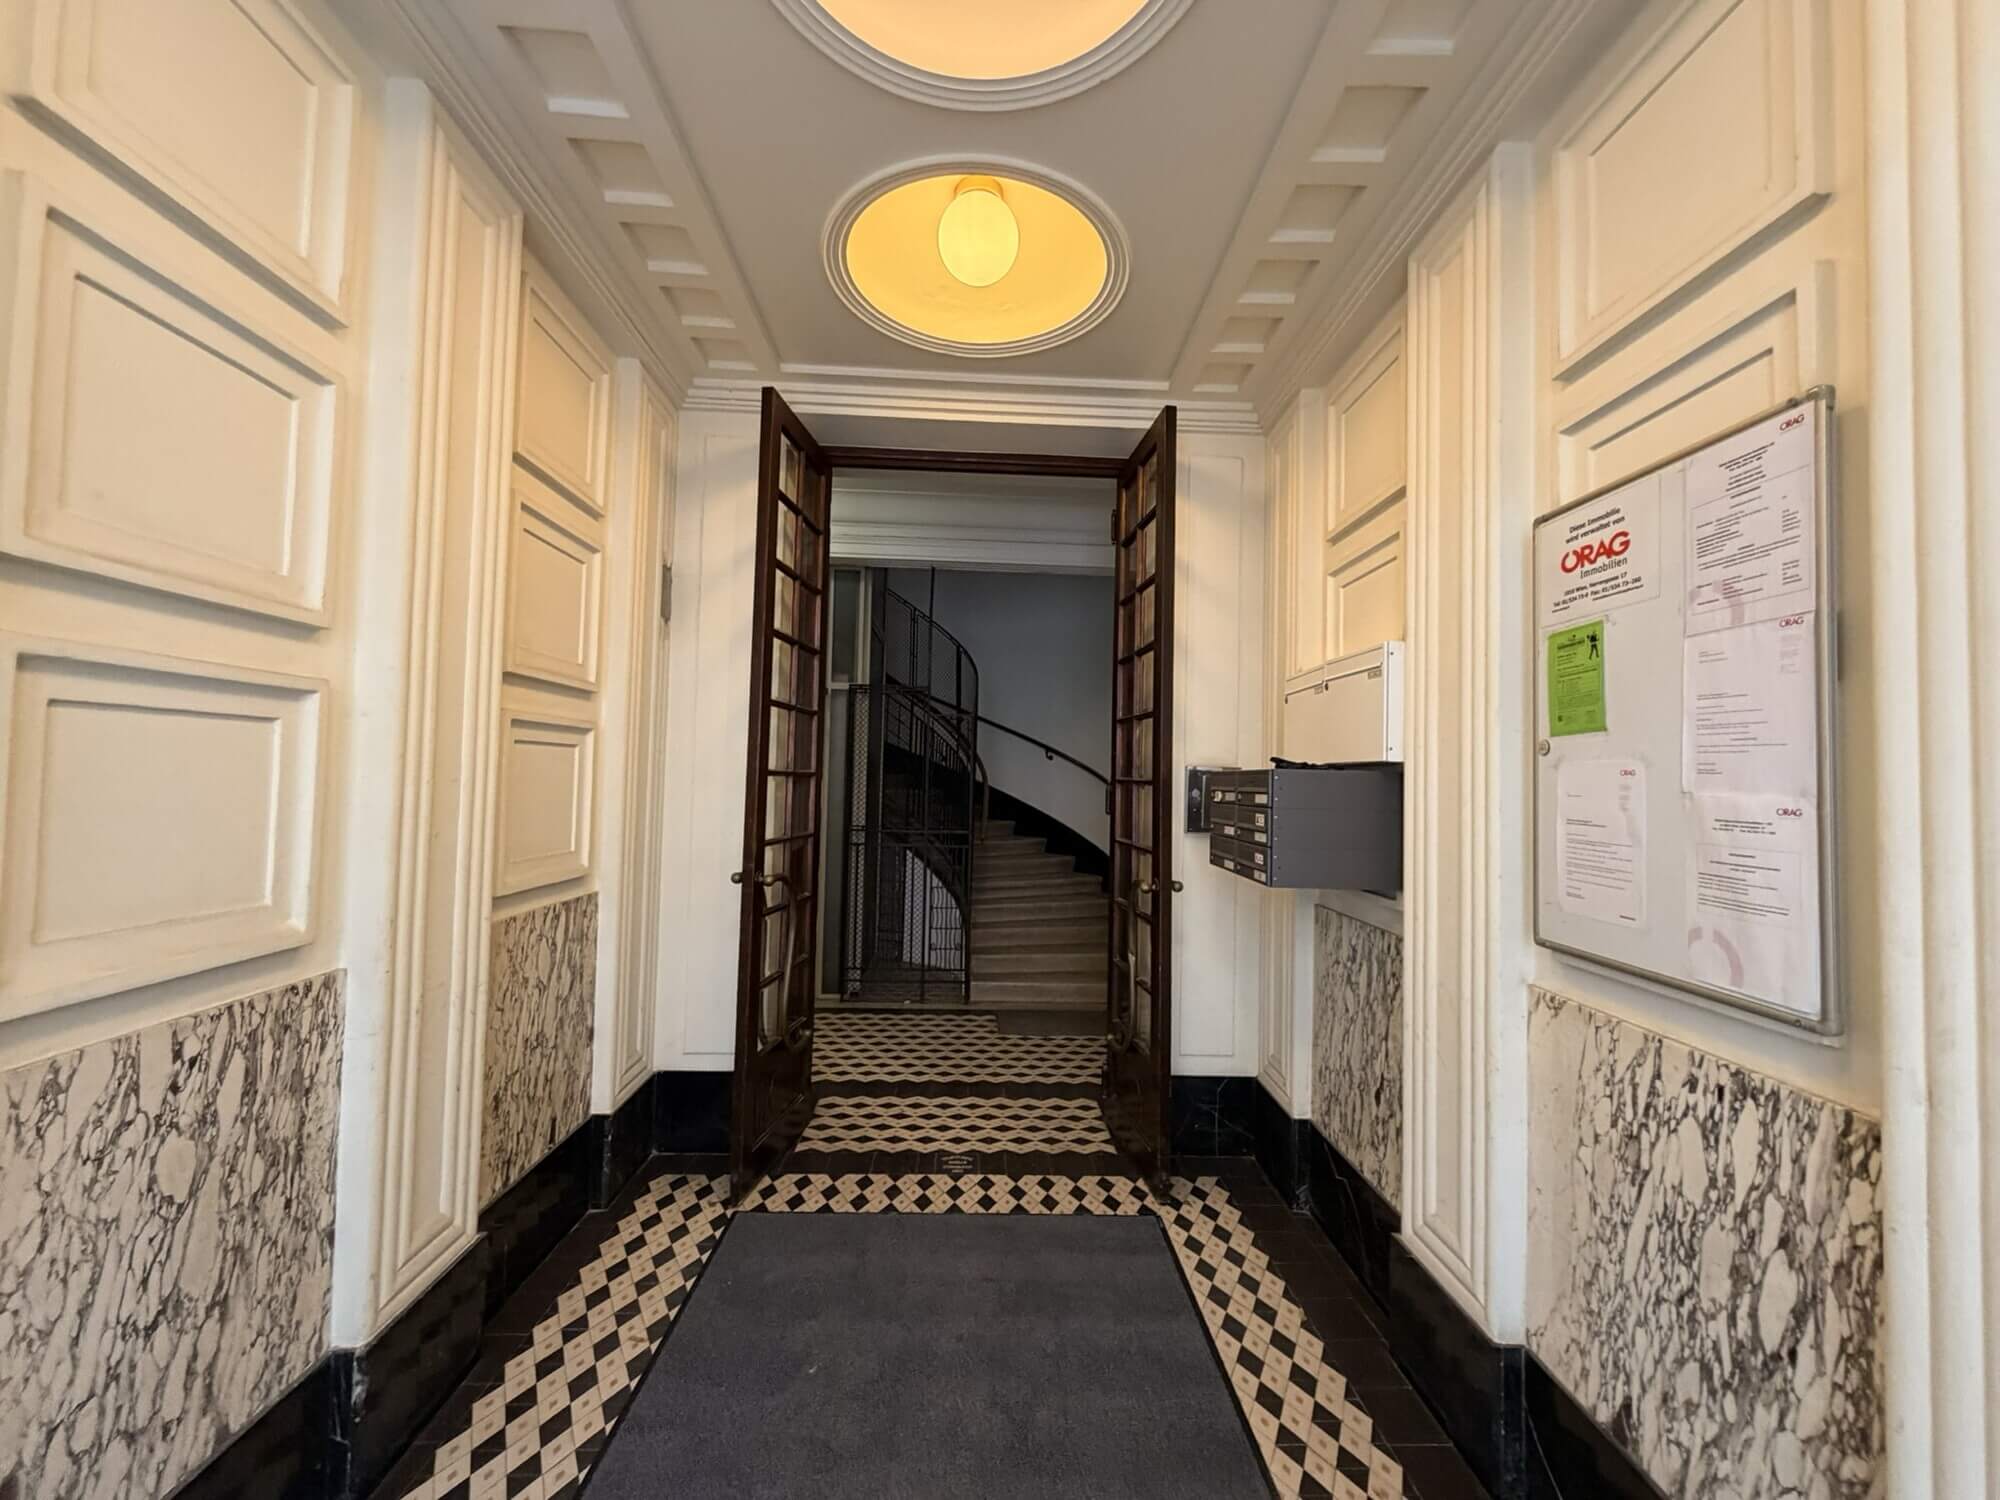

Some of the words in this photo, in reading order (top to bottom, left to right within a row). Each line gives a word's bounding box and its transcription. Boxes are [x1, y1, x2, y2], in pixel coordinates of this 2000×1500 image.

[1779, 413, 1805, 431] ORAG
[1565, 533, 1579, 544] wird
[1580, 521, 1611, 538] verwaltet
[1612, 516, 1626, 526] von
[1569, 522, 1586, 534] Diese
[1588, 507, 1621, 526] Immobilie
[1560, 530, 1631, 574] ORAG
[1580, 557, 1628, 579] Immobilien
[1779, 615, 1805, 628] ORAG
[1775, 807, 1804, 818] ORAG
